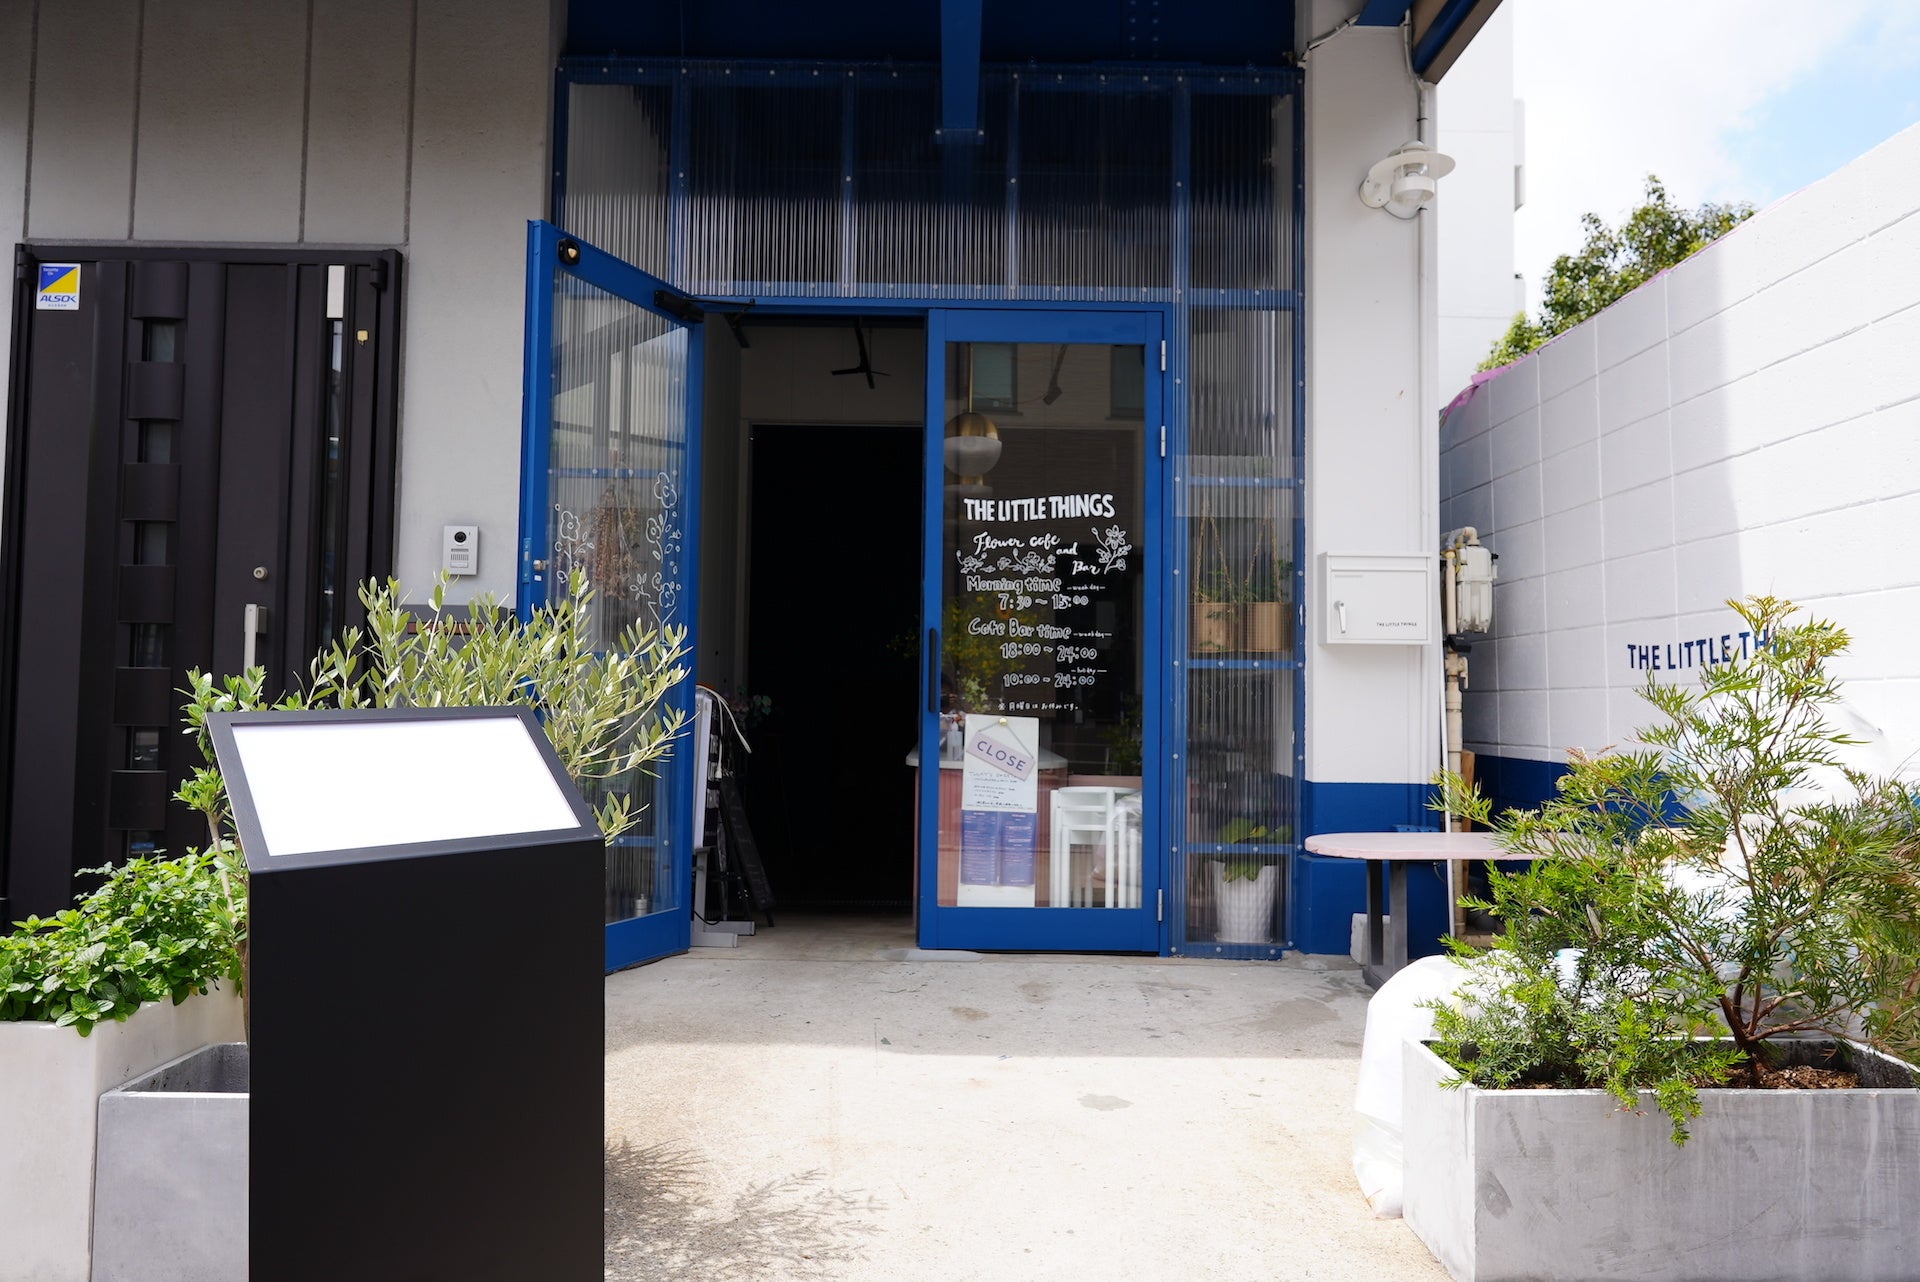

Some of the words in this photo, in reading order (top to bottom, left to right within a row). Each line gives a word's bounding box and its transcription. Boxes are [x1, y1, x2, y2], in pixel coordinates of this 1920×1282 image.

[964, 498, 995, 521] THE
[998, 498, 1047, 522] LITTLE
[1048, 494, 1115, 518] THINGS
[973, 531, 1025, 555] Flower
[1029, 533, 1061, 550] cafe
[1056, 542, 1078, 555] and
[1072, 560, 1100, 575] Bar
[966, 575, 1023, 594] Morning
[1024, 576, 1062, 592] time
[998, 593, 1032, 610] 7:30
[968, 617, 1006, 636] Cafe
[1008, 617, 1035, 637] Bar
[1036, 624, 1072, 640] time
[1000, 642, 1041, 659] 18:00
[1056, 645, 1097, 663] 24:00
[1627, 644, 1660, 670] THE
[1667, 635, 1731, 669] LITTLE
[1003, 673, 1040, 687] 10:00
[1054, 673, 1095, 688] 24:00
[977, 740, 1026, 771] CLOSE
